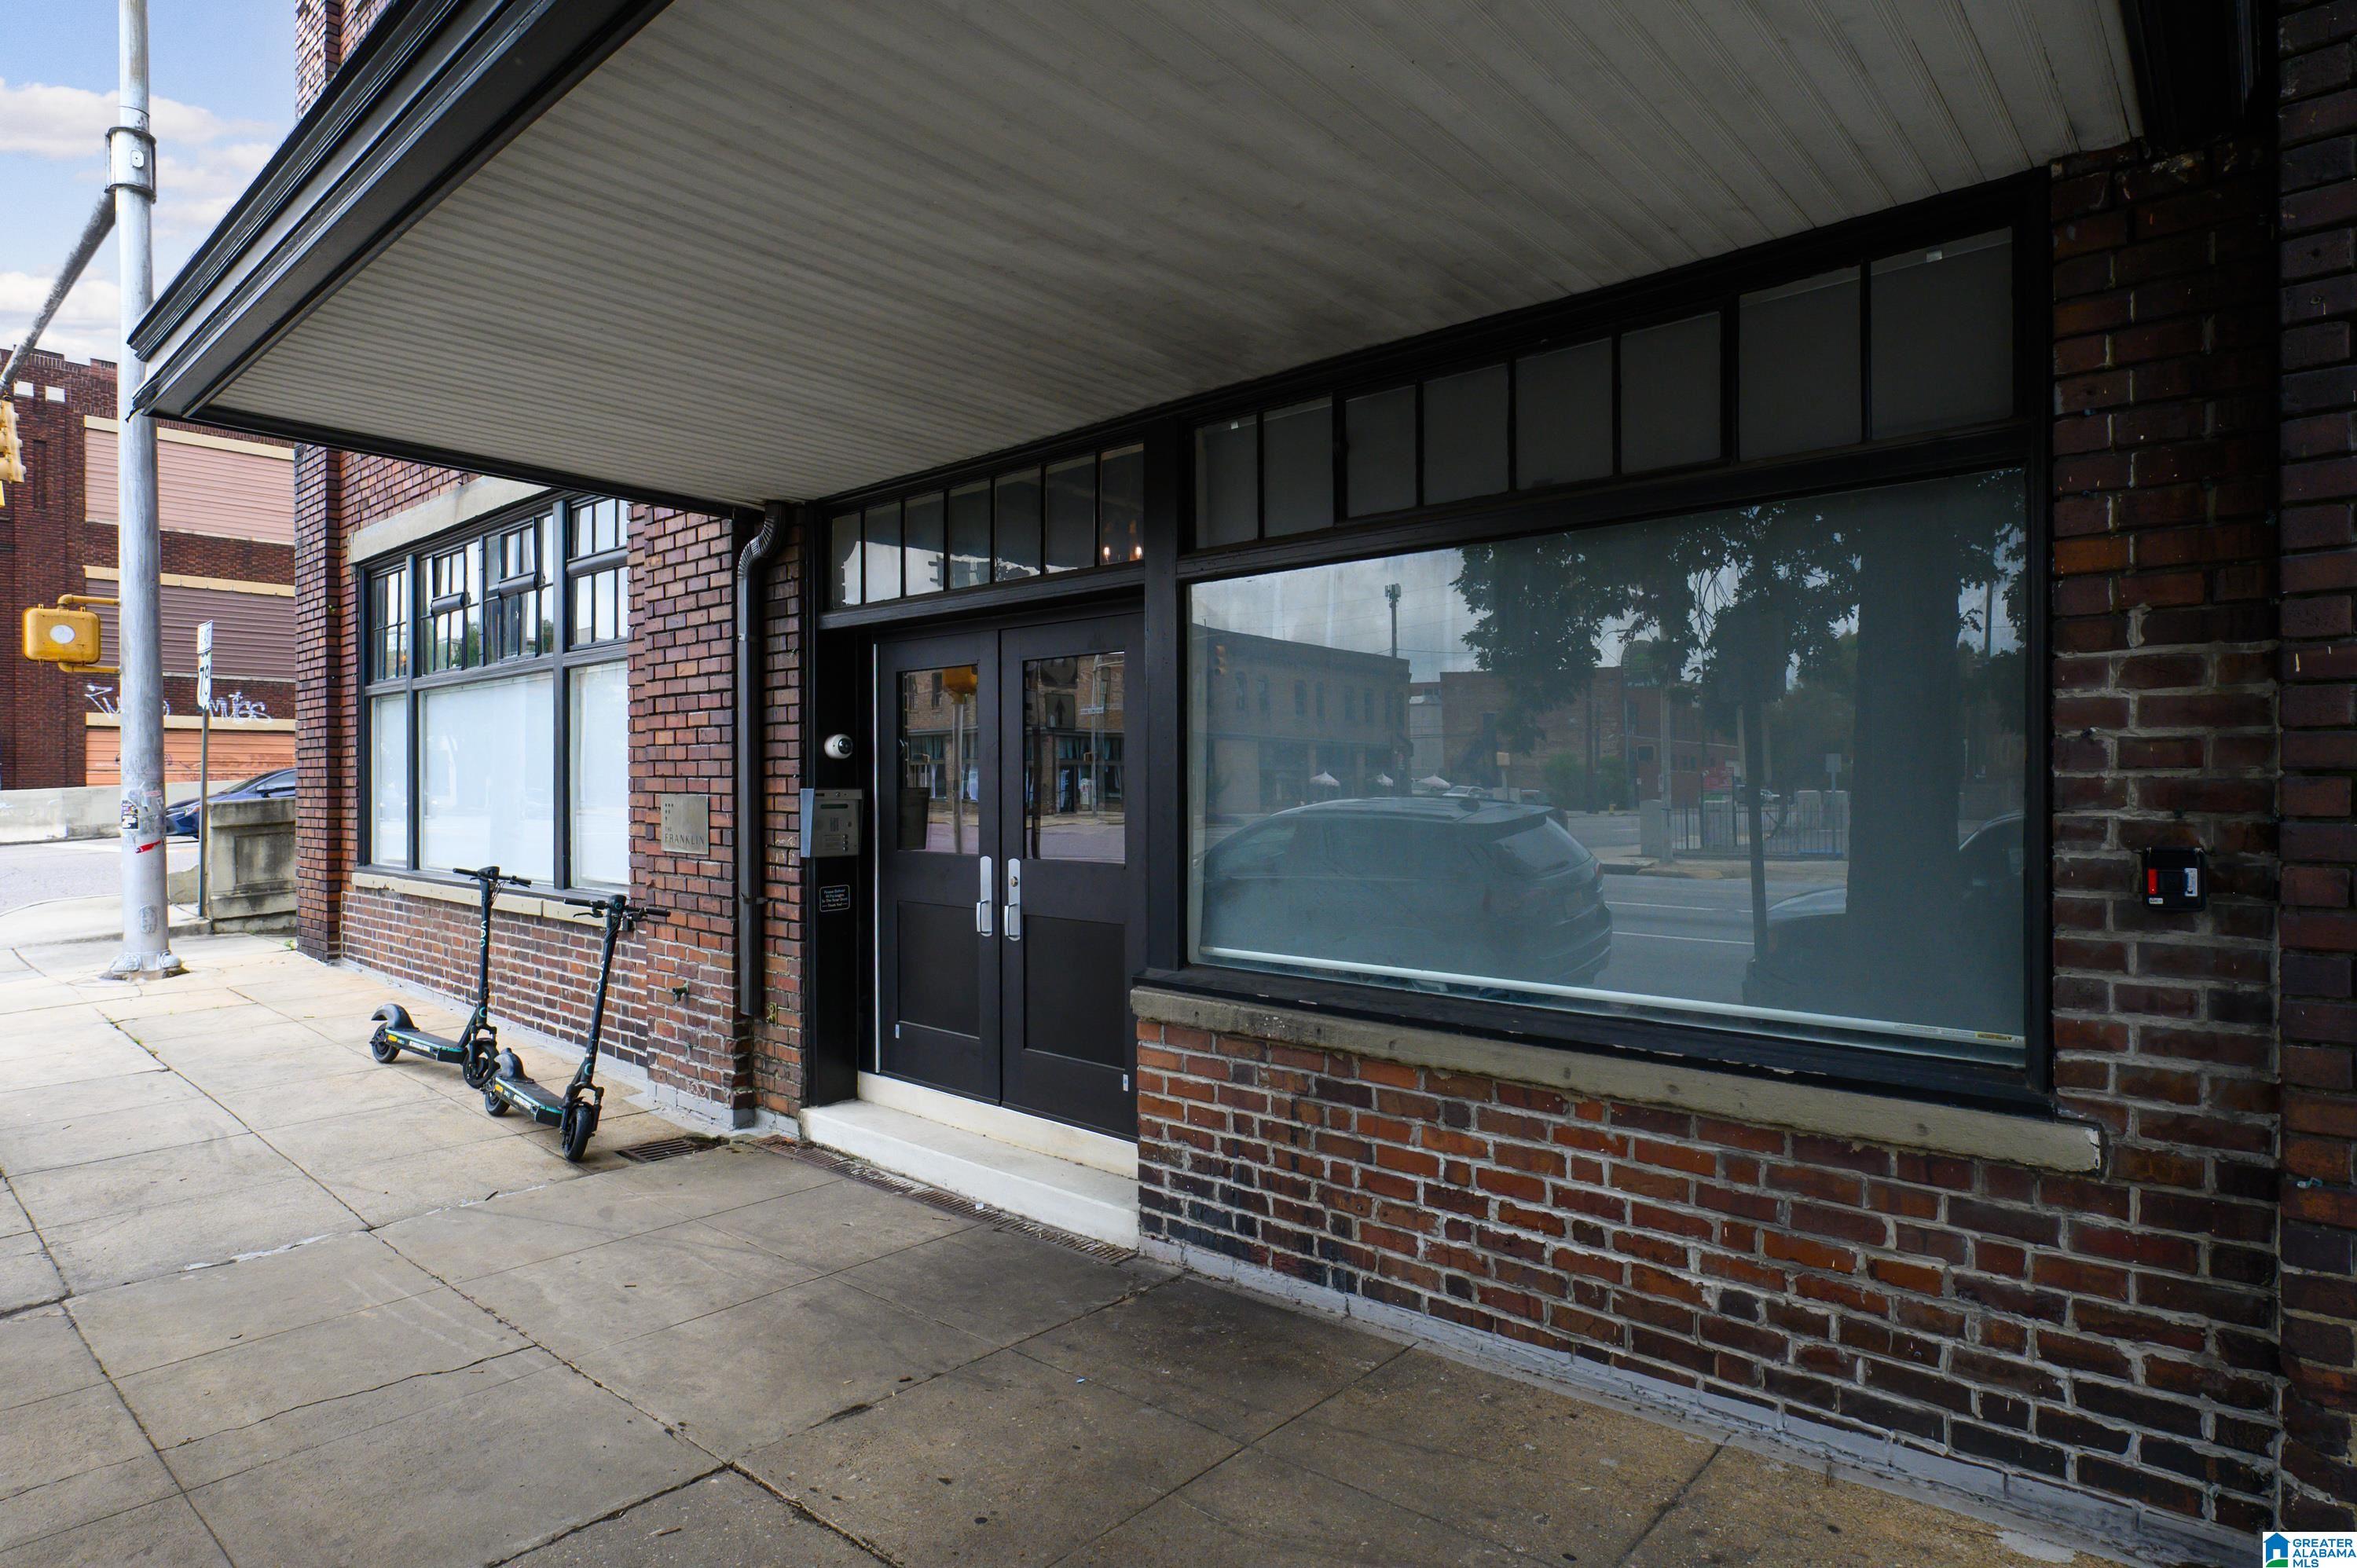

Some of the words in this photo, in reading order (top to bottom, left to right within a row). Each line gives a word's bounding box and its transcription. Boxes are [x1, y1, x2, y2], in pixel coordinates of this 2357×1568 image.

[200, 628, 211, 646] EAST
[199, 665, 208, 696] 78
[665, 833, 705, 845] FRANKLIN
